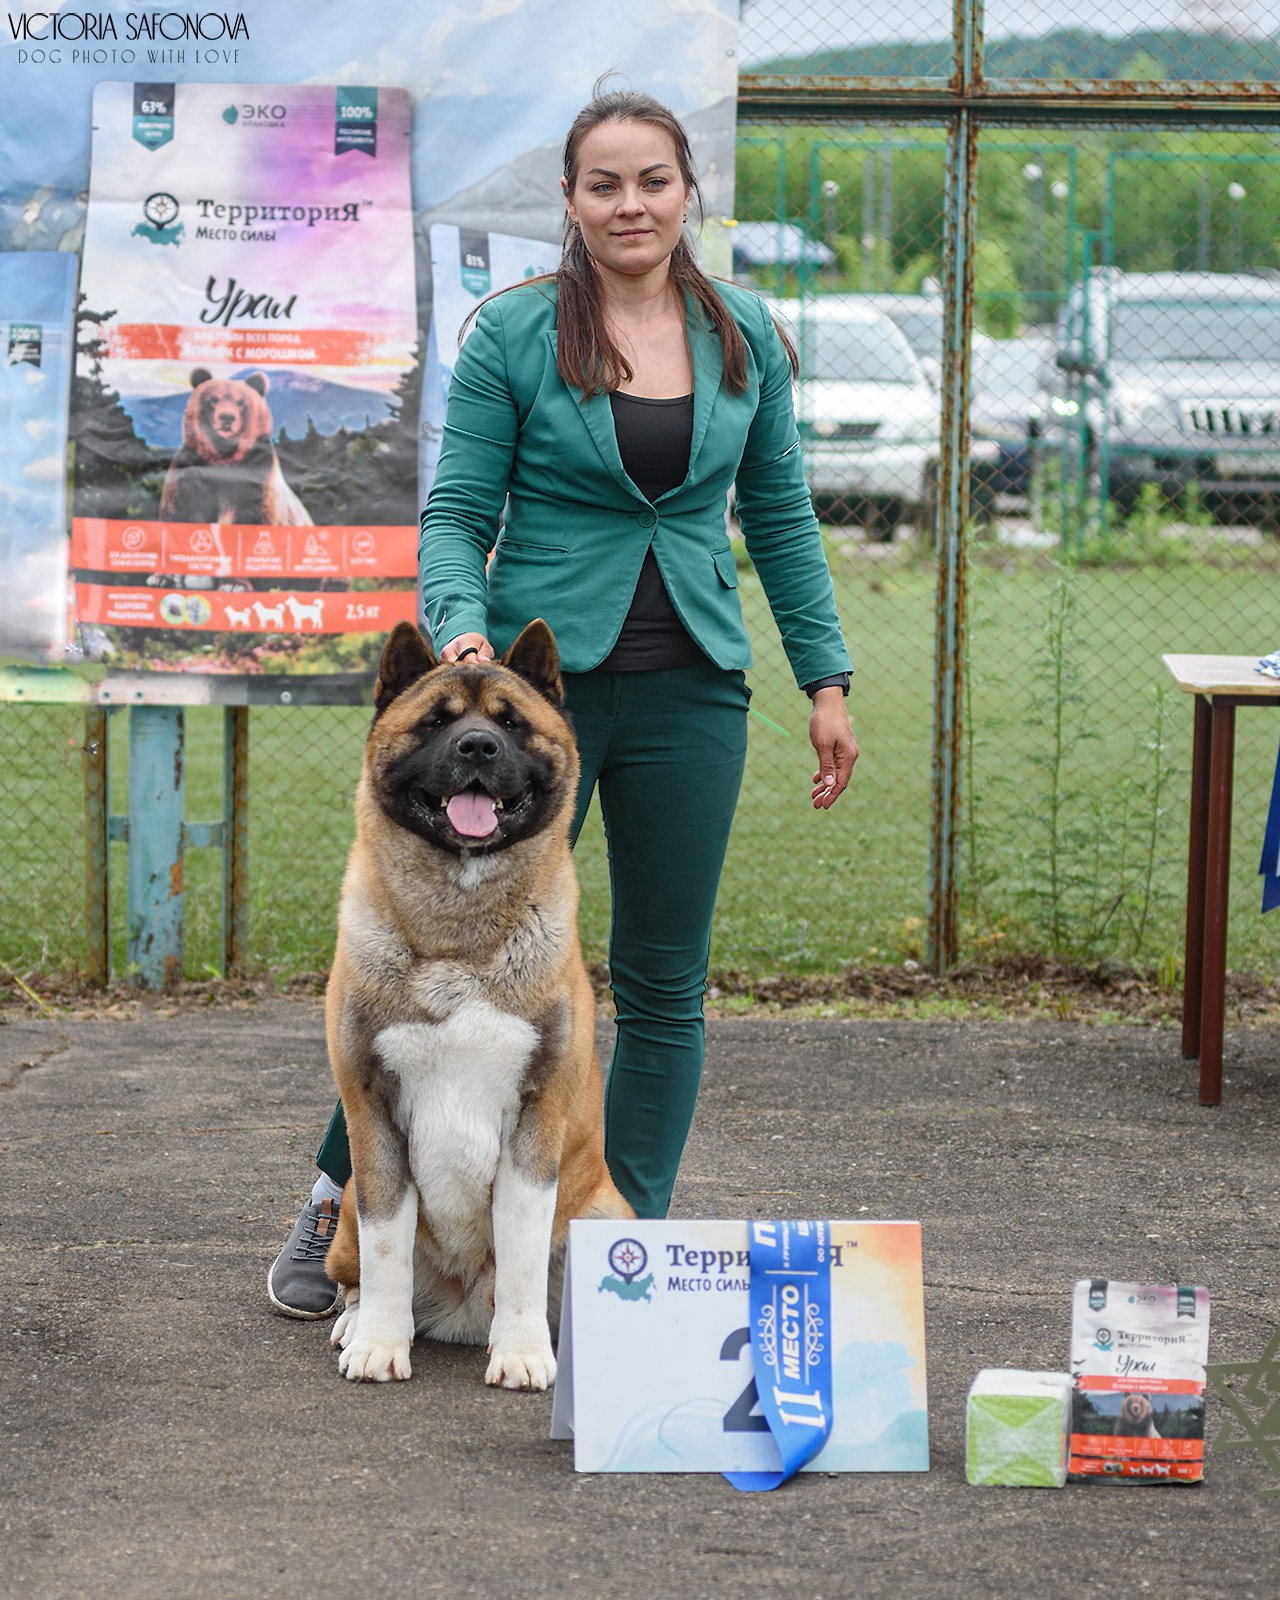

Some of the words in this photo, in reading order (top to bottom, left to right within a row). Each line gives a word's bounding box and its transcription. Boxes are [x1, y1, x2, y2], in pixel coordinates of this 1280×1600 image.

[141, 100, 167, 114] 63%
[242, 104, 287, 119] ЭКО
[340, 106, 373, 119] 100%
[199, 275, 298, 327] Урал
[781, 1284, 800, 1380] МЕСТО
